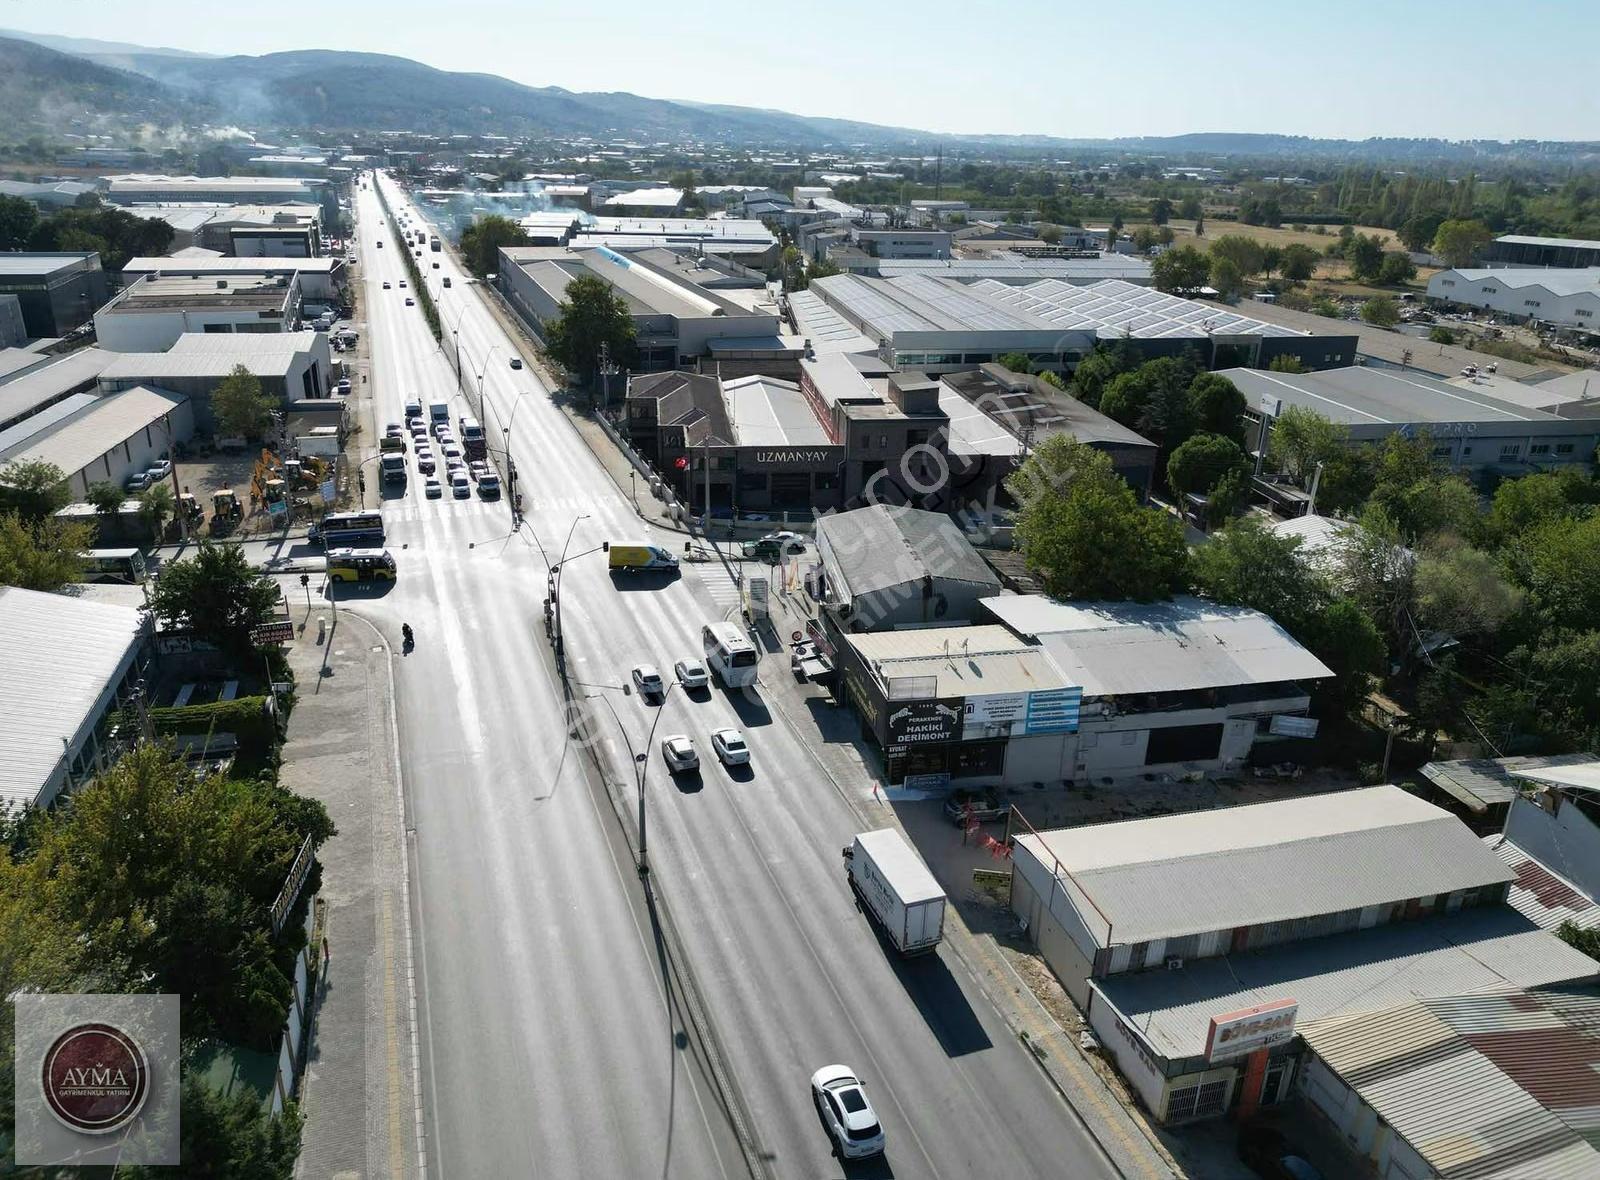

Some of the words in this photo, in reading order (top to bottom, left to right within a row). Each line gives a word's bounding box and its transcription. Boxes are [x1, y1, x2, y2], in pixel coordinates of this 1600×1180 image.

[757, 451, 828, 462] UZMANYAY
[906, 722, 943, 733] HAKİKİ
[897, 732, 952, 743] DERİMONT
